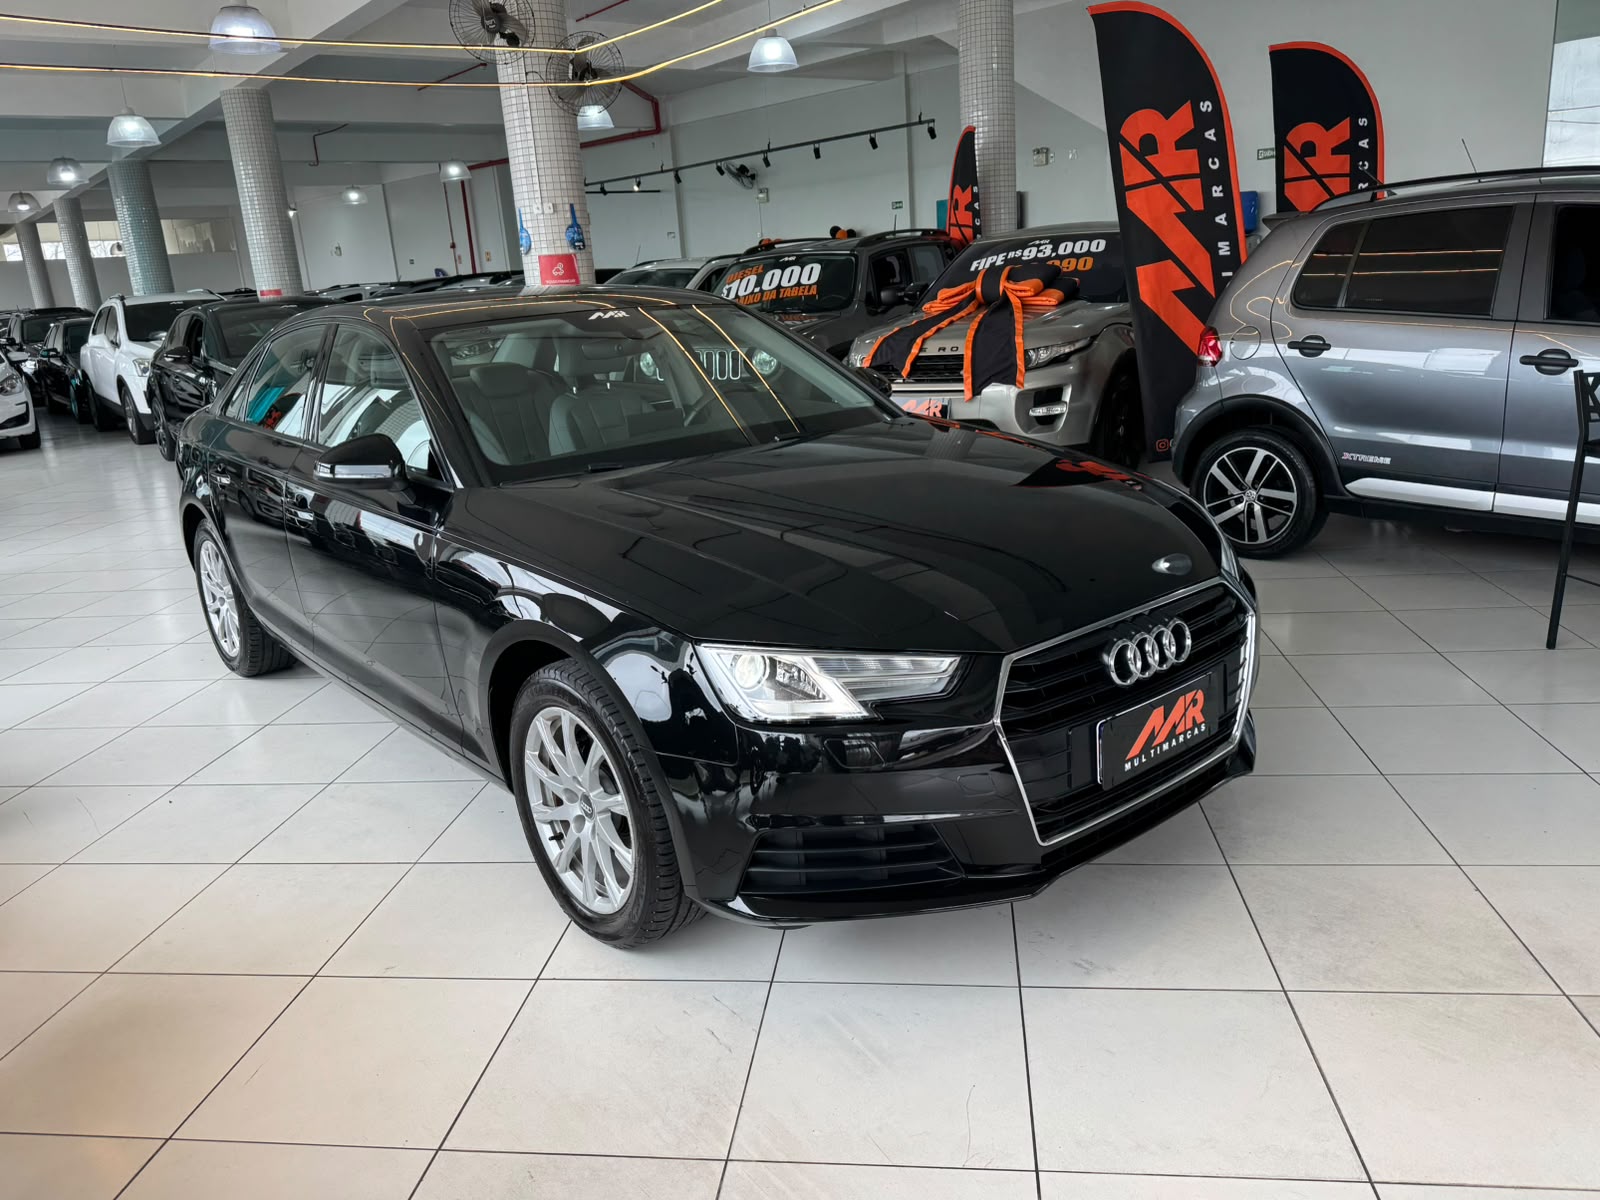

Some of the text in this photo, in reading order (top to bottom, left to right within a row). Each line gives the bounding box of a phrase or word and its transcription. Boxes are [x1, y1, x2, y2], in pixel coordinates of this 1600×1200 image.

[970, 252, 1007, 272] FIPE
[726, 264, 764, 285] DIESEL
[763, 289, 777, 303] DA
[780, 286, 817, 298] TABELA
[1124, 723, 1207, 772] MULTIMARCAS
